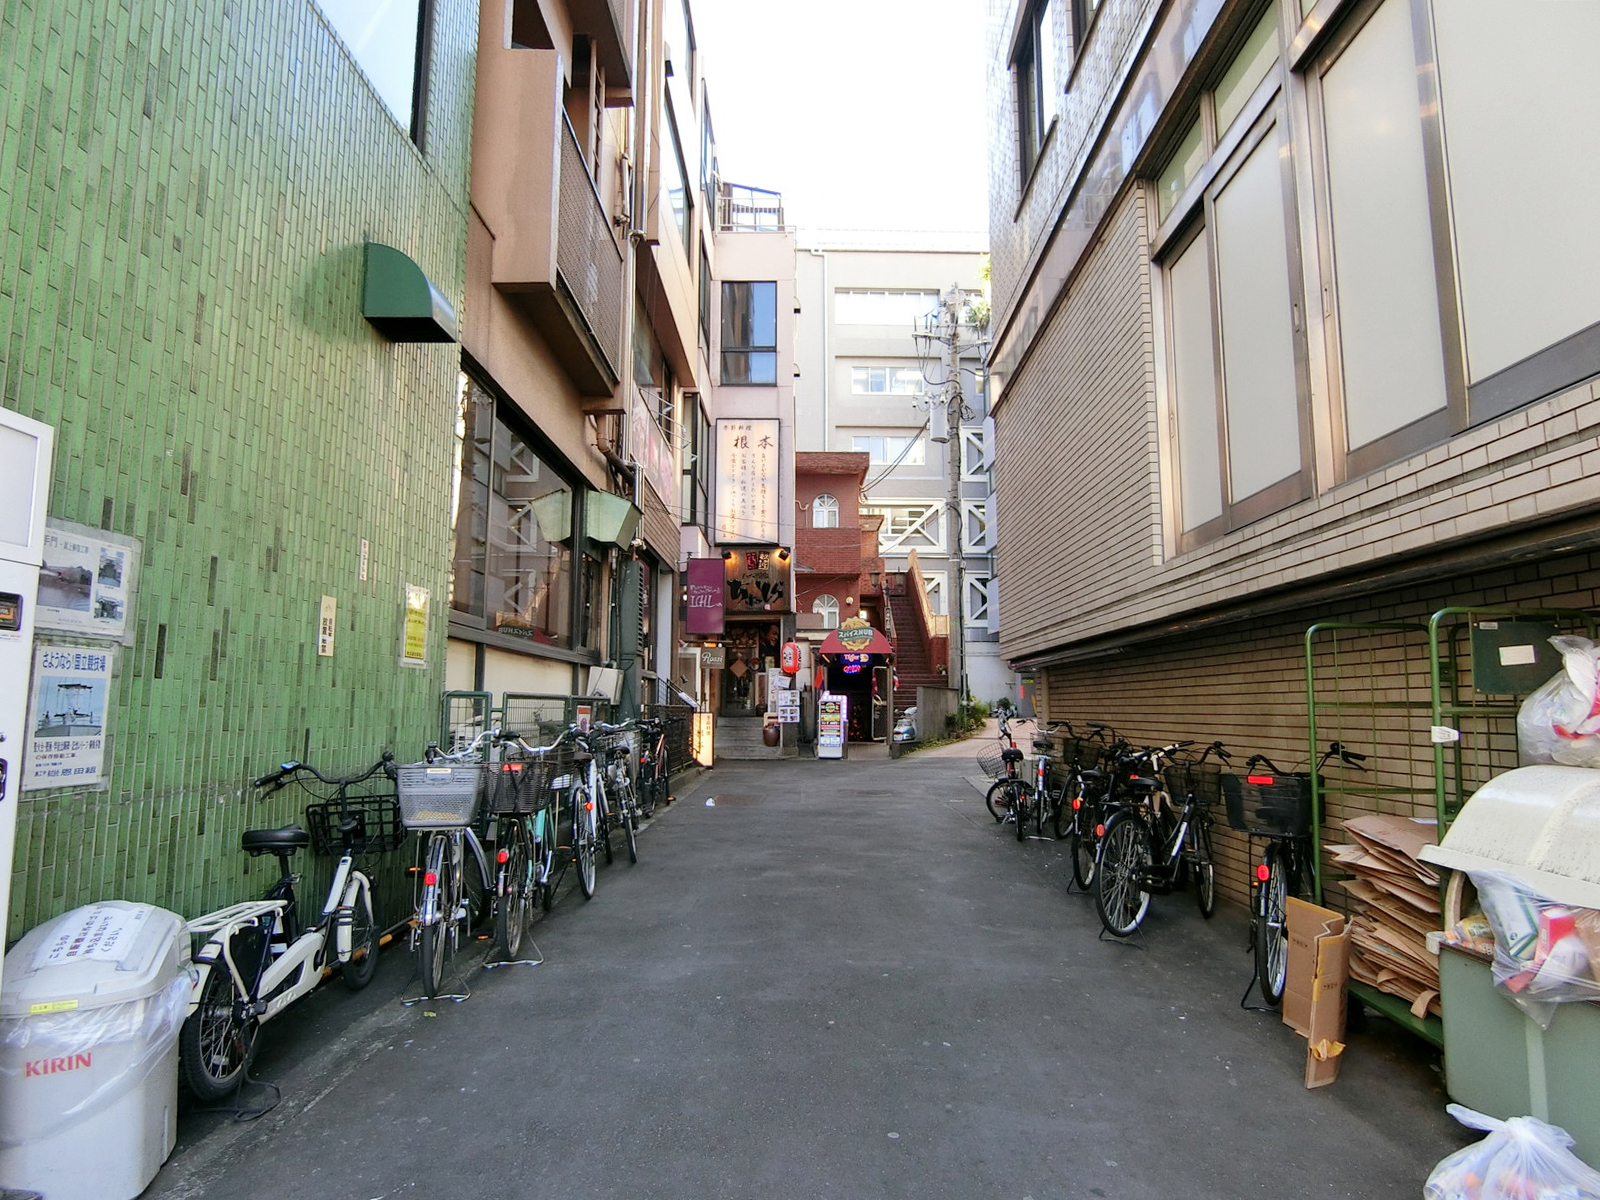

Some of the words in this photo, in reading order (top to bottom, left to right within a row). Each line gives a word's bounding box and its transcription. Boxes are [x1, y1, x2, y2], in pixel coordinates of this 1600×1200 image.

[838, 628, 874, 639] スパイスHUB
[25, 1052, 92, 1078] KIRIN
